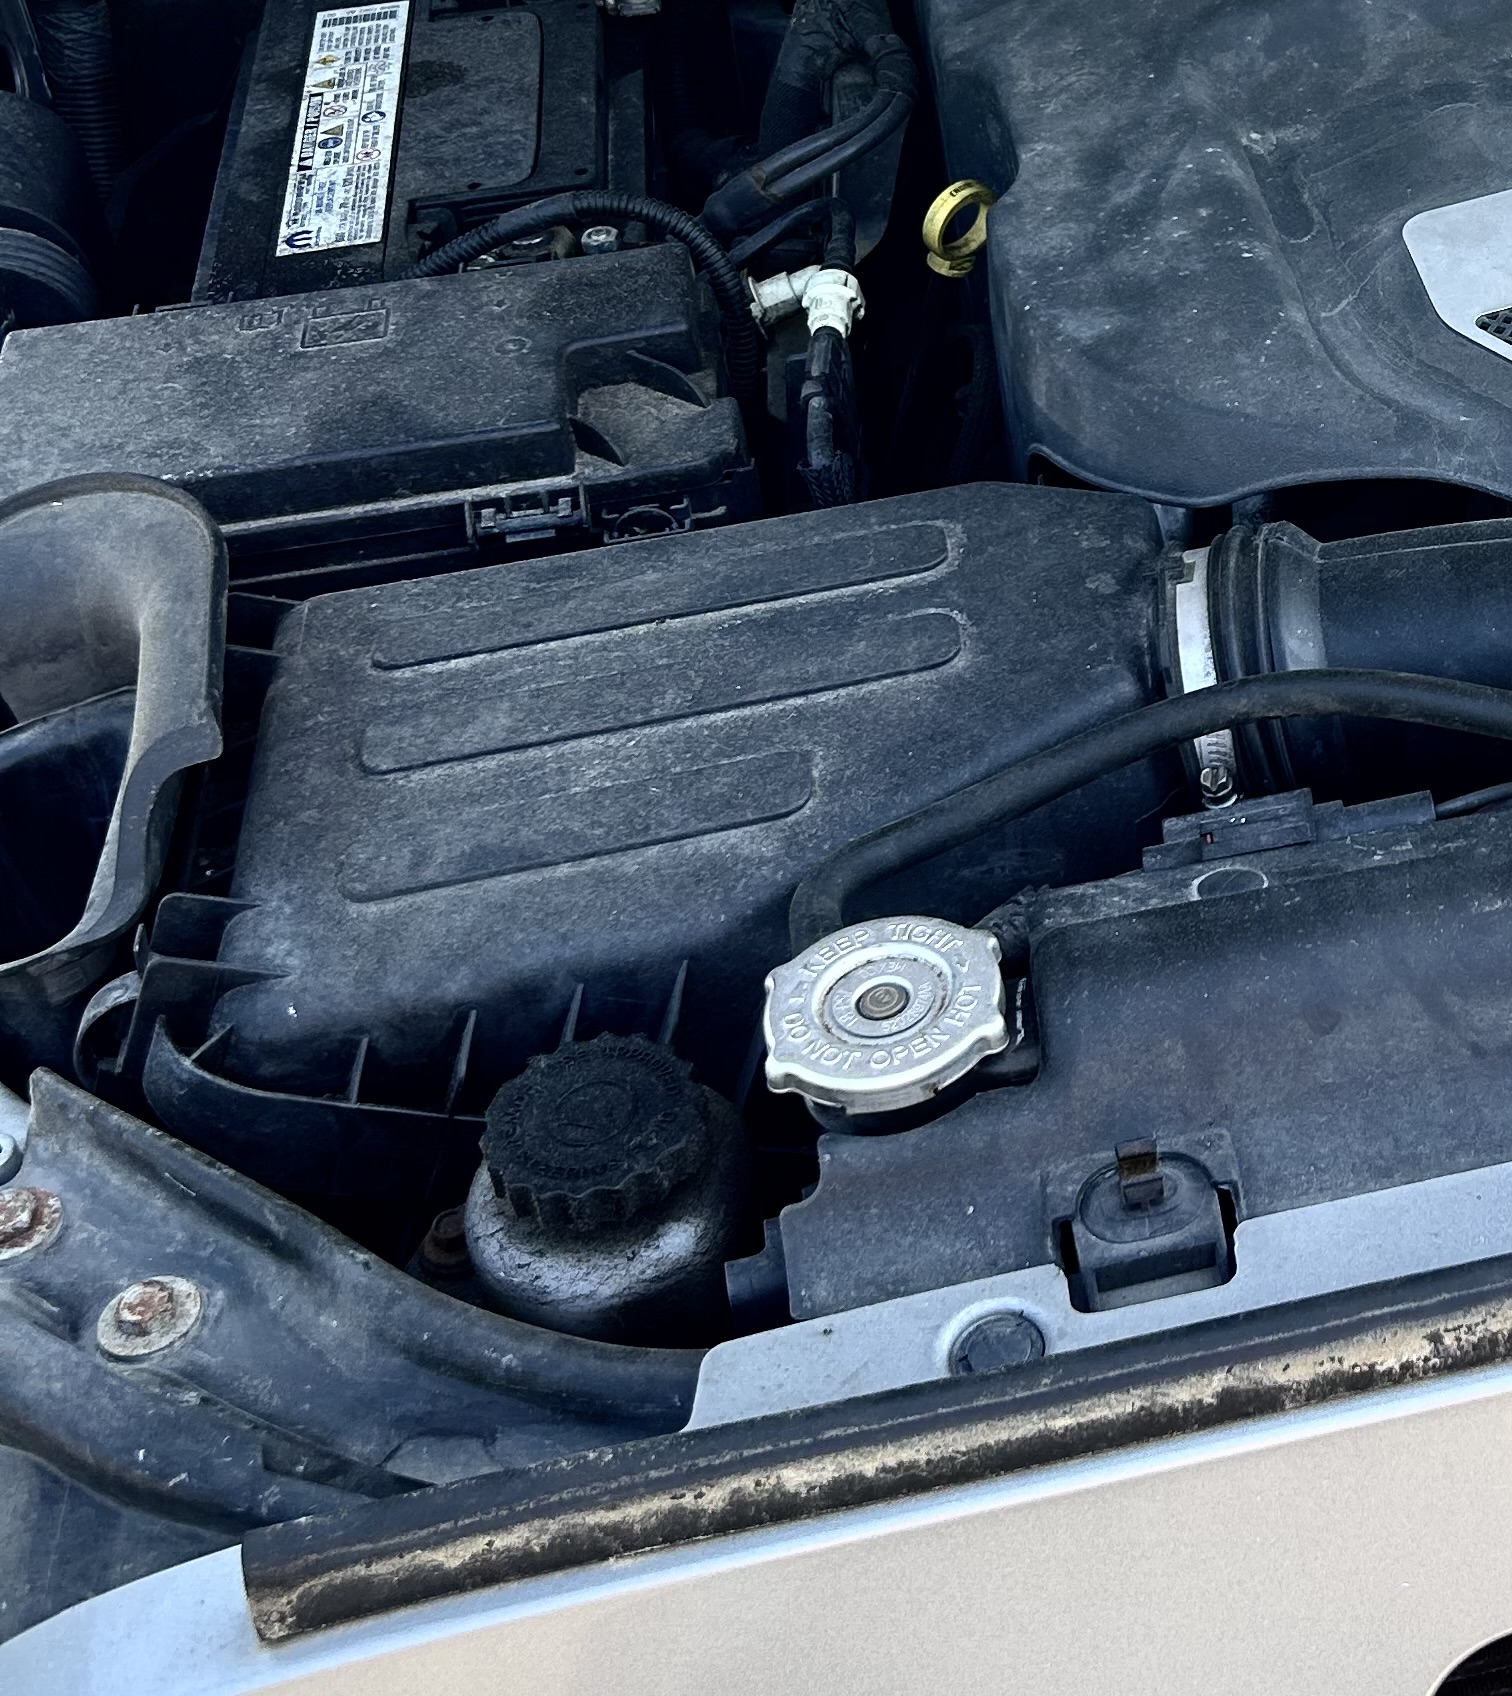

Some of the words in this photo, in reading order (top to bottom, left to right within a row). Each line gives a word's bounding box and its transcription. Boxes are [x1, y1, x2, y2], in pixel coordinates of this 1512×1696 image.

[799, 928, 870, 978] KEEP
[887, 922, 964, 954] TIGHT
[783, 1012, 811, 1042] DO
[801, 1038, 862, 1070] NOT
[869, 1027, 951, 1070] OPEN
[944, 984, 982, 1028] HOT
